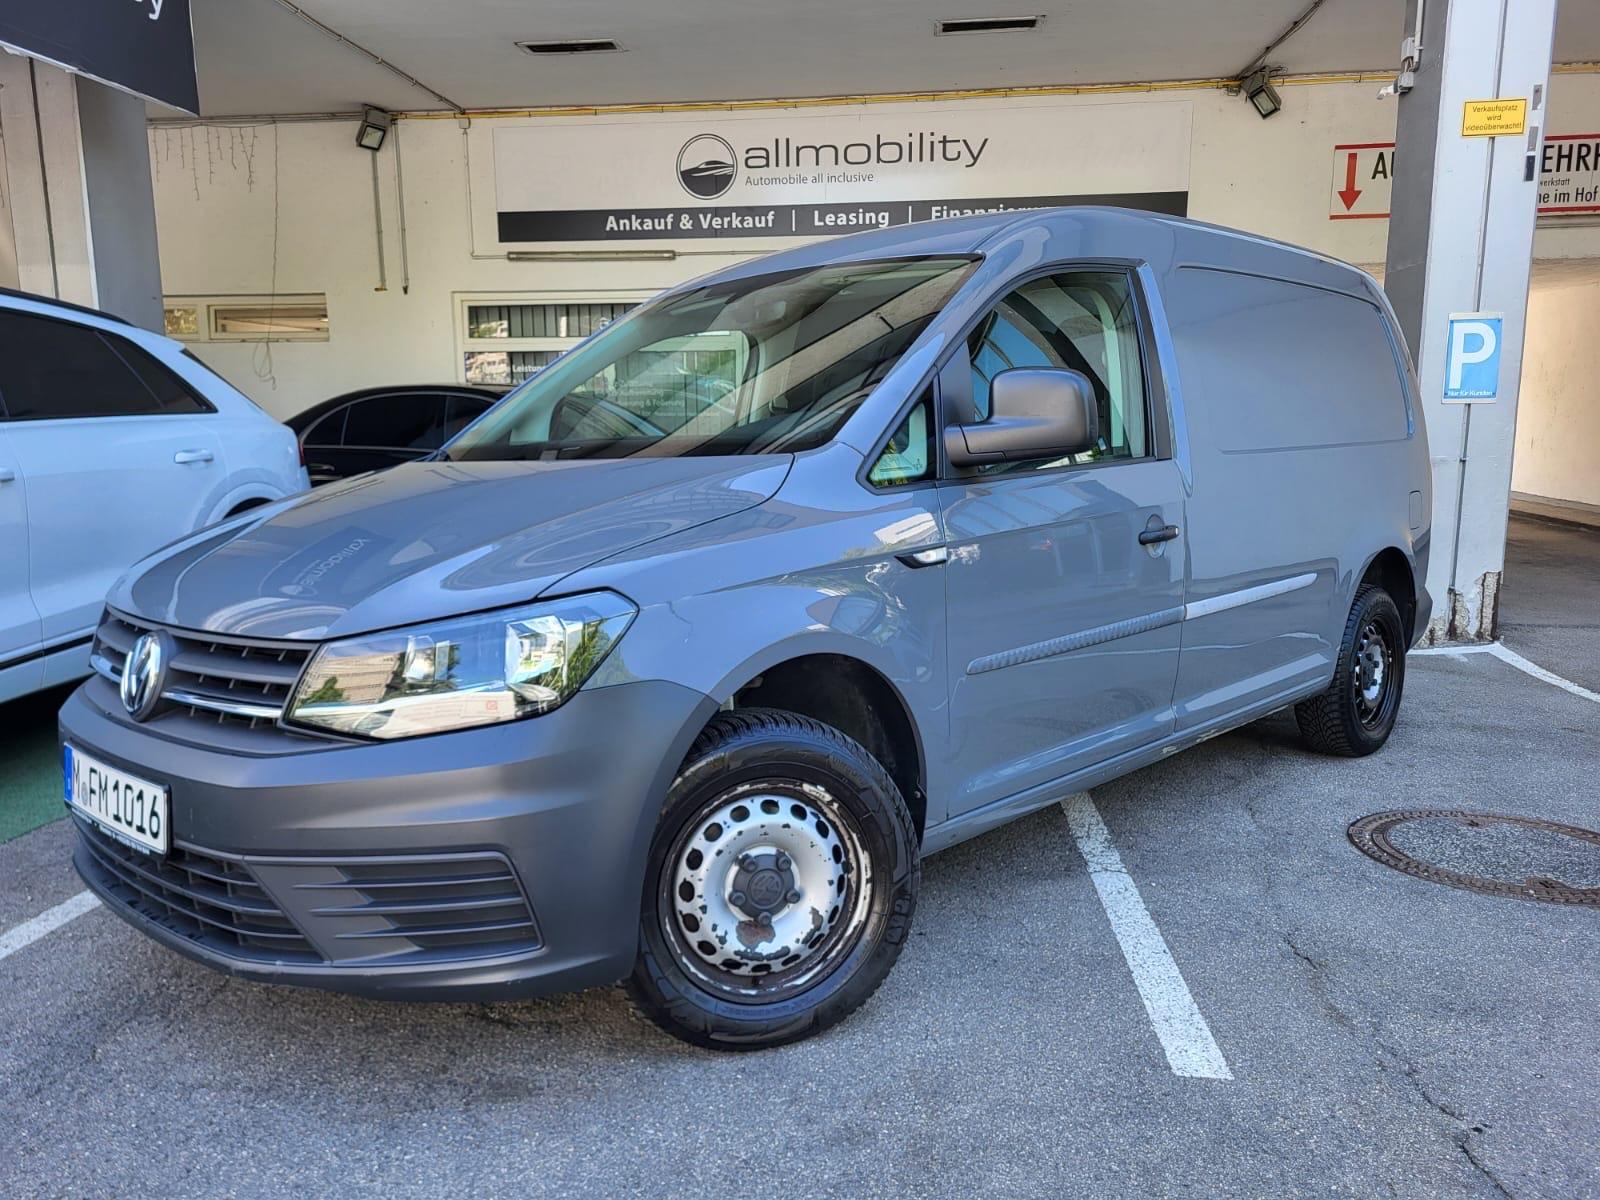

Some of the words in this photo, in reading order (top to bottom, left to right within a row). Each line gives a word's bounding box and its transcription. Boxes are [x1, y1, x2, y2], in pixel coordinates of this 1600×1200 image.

[1472, 104, 1518, 113] Verkaufsplatz
[744, 131, 989, 168] allmobility
[745, 174, 808, 187] Automobile
[811, 172, 825, 184] all
[827, 172, 874, 184] inclusive
[1554, 189, 1570, 203] im
[1575, 185, 1598, 202] Hof
[606, 213, 674, 231] Ankauf
[679, 213, 693, 229] &
[699, 211, 775, 229] Verkauf
[813, 208, 890, 228] Leasing
[1448, 321, 1497, 389] P
[89, 766, 109, 818] FM
[112, 779, 161, 840] 1016
